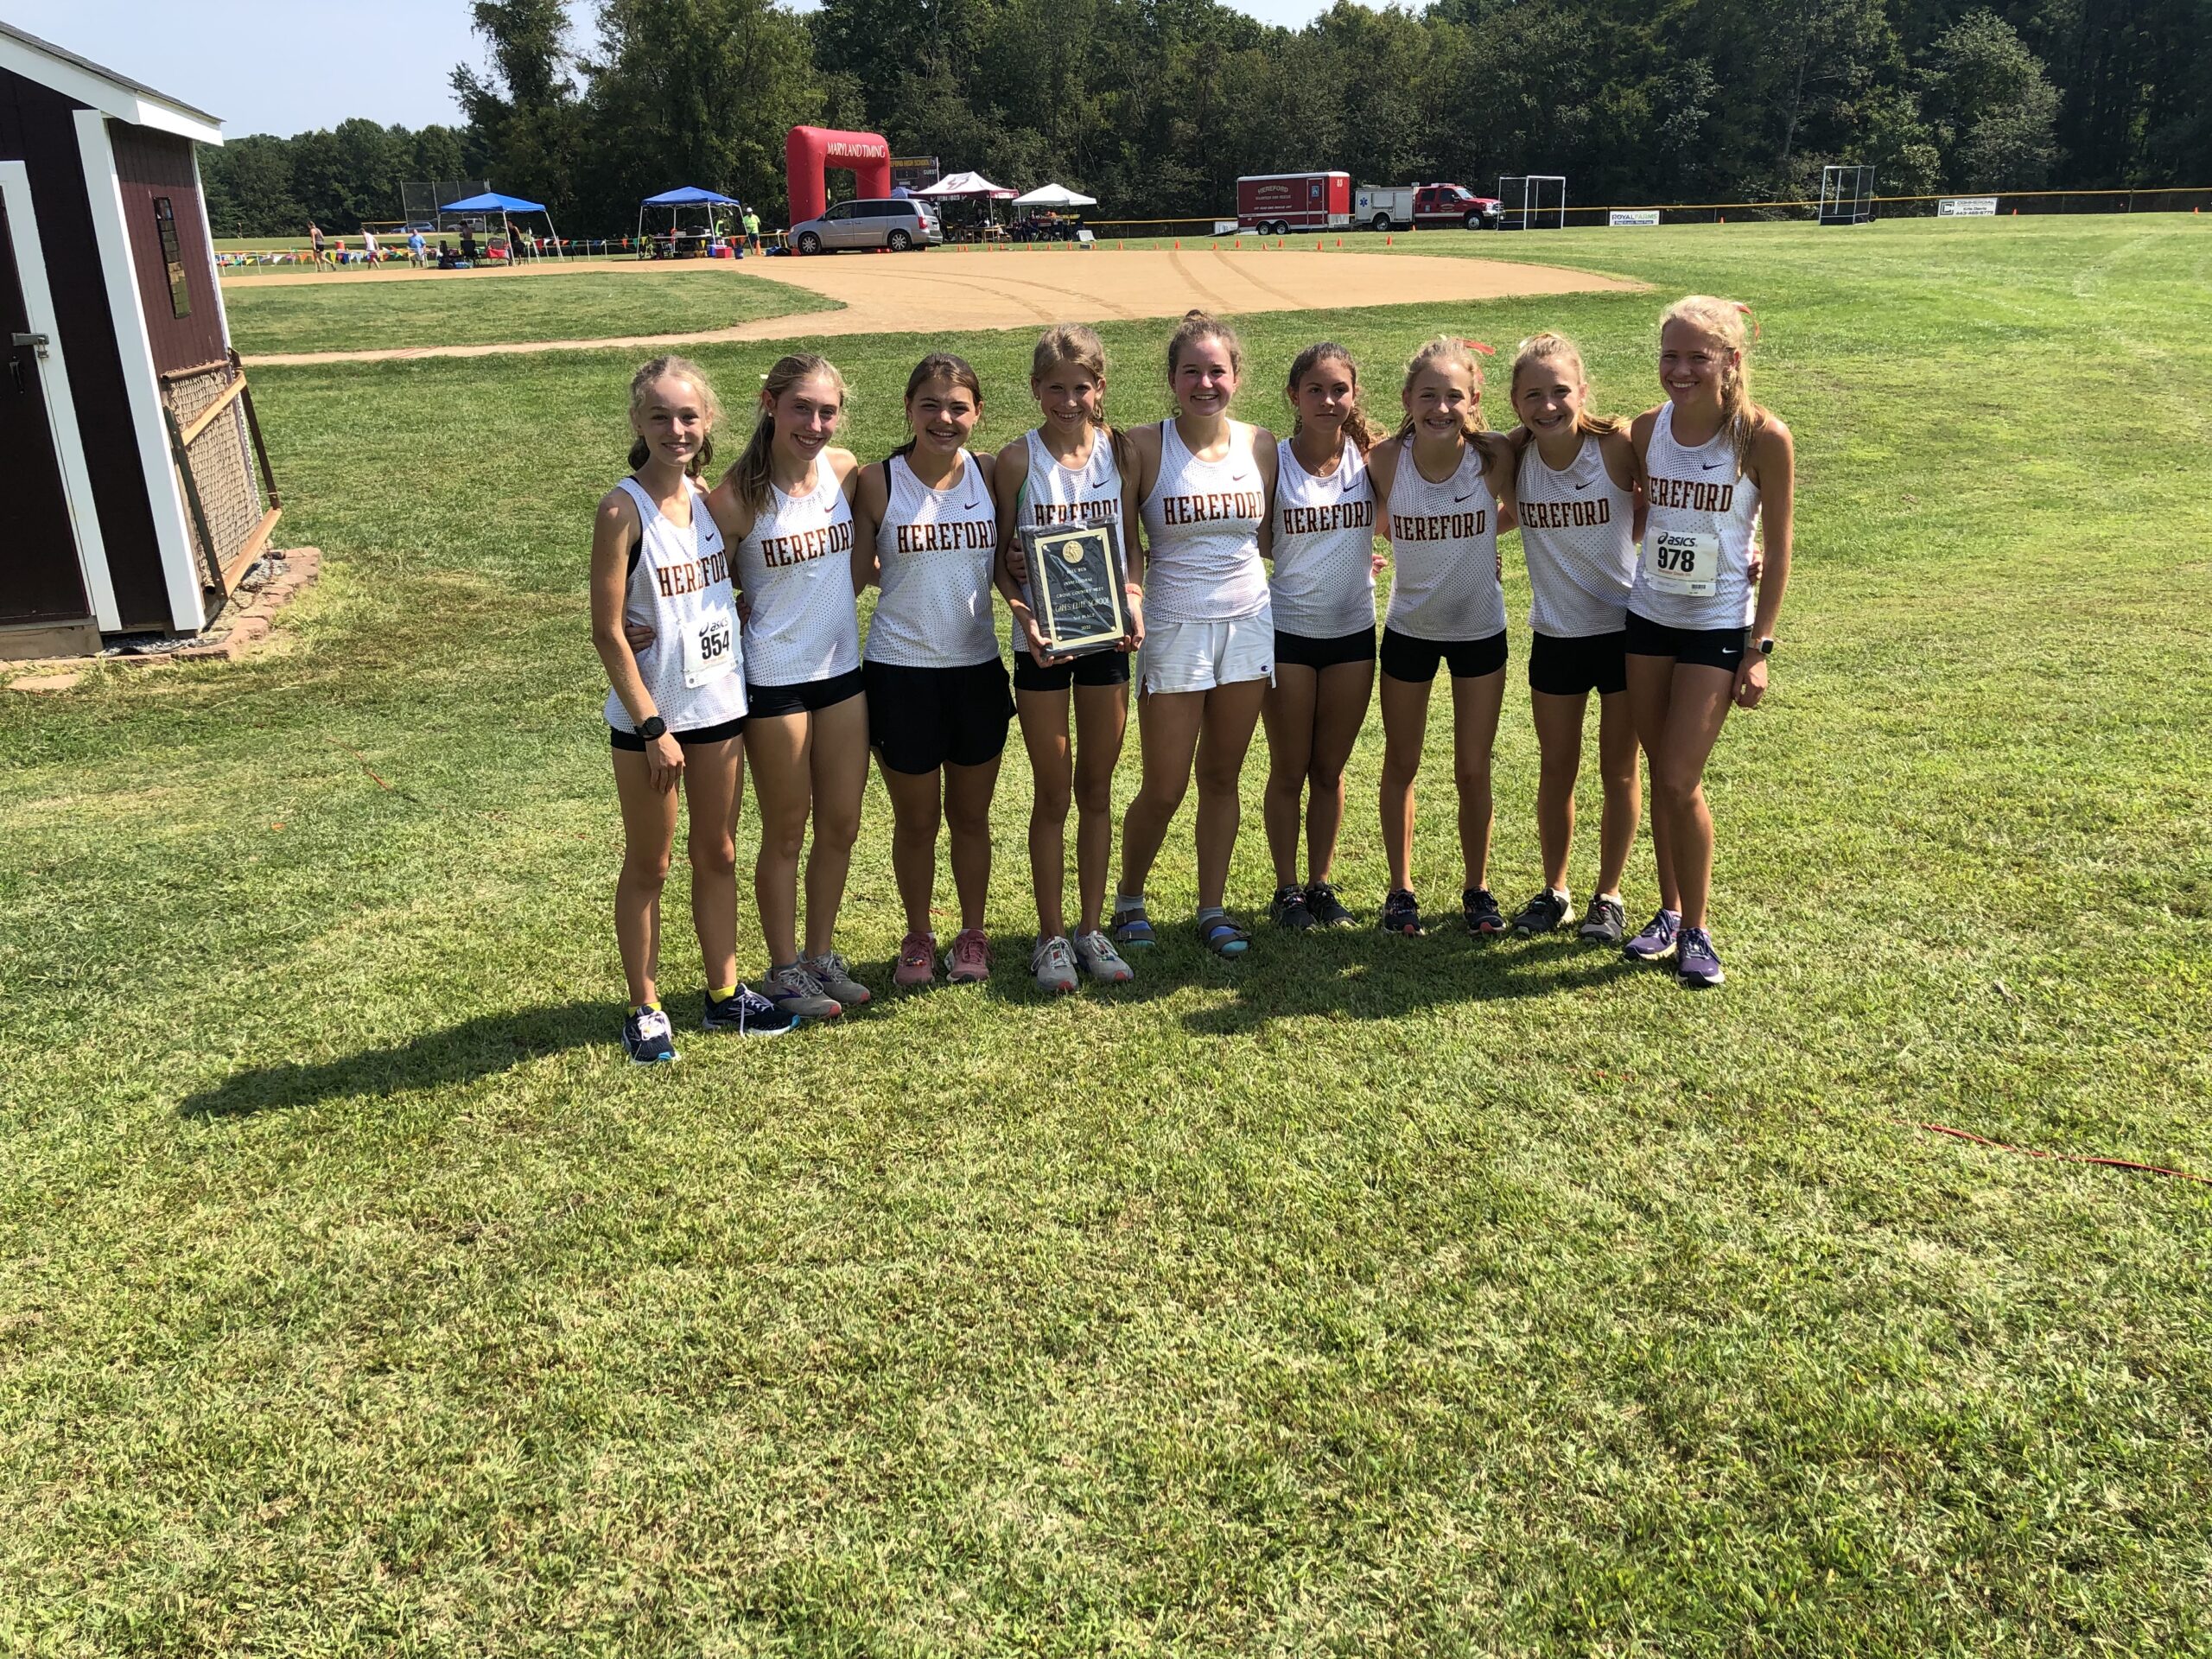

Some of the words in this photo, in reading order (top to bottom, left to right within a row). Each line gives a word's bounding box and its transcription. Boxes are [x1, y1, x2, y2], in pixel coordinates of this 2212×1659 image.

[827, 141, 862, 157] MARYLAND
[862, 144, 886, 158] TIMING
[1163, 491, 1264, 525] HEREFORD
[1648, 476, 1733, 512] EREFORD
[1283, 500, 1373, 535] HEREFORD
[1393, 510, 1485, 541] HEREFORD
[1519, 498, 1610, 529] HEREFORD
[897, 519, 995, 553] HEREFORD
[1668, 536, 1696, 547] asics
[657, 550, 731, 597] HEREFOR
[1657, 546, 1695, 572] 978
[1055, 604, 1071, 613] GIRLS
[1088, 596, 1109, 607] SCHOOL
[710, 617, 728, 632] asics
[701, 630, 729, 660] 954
